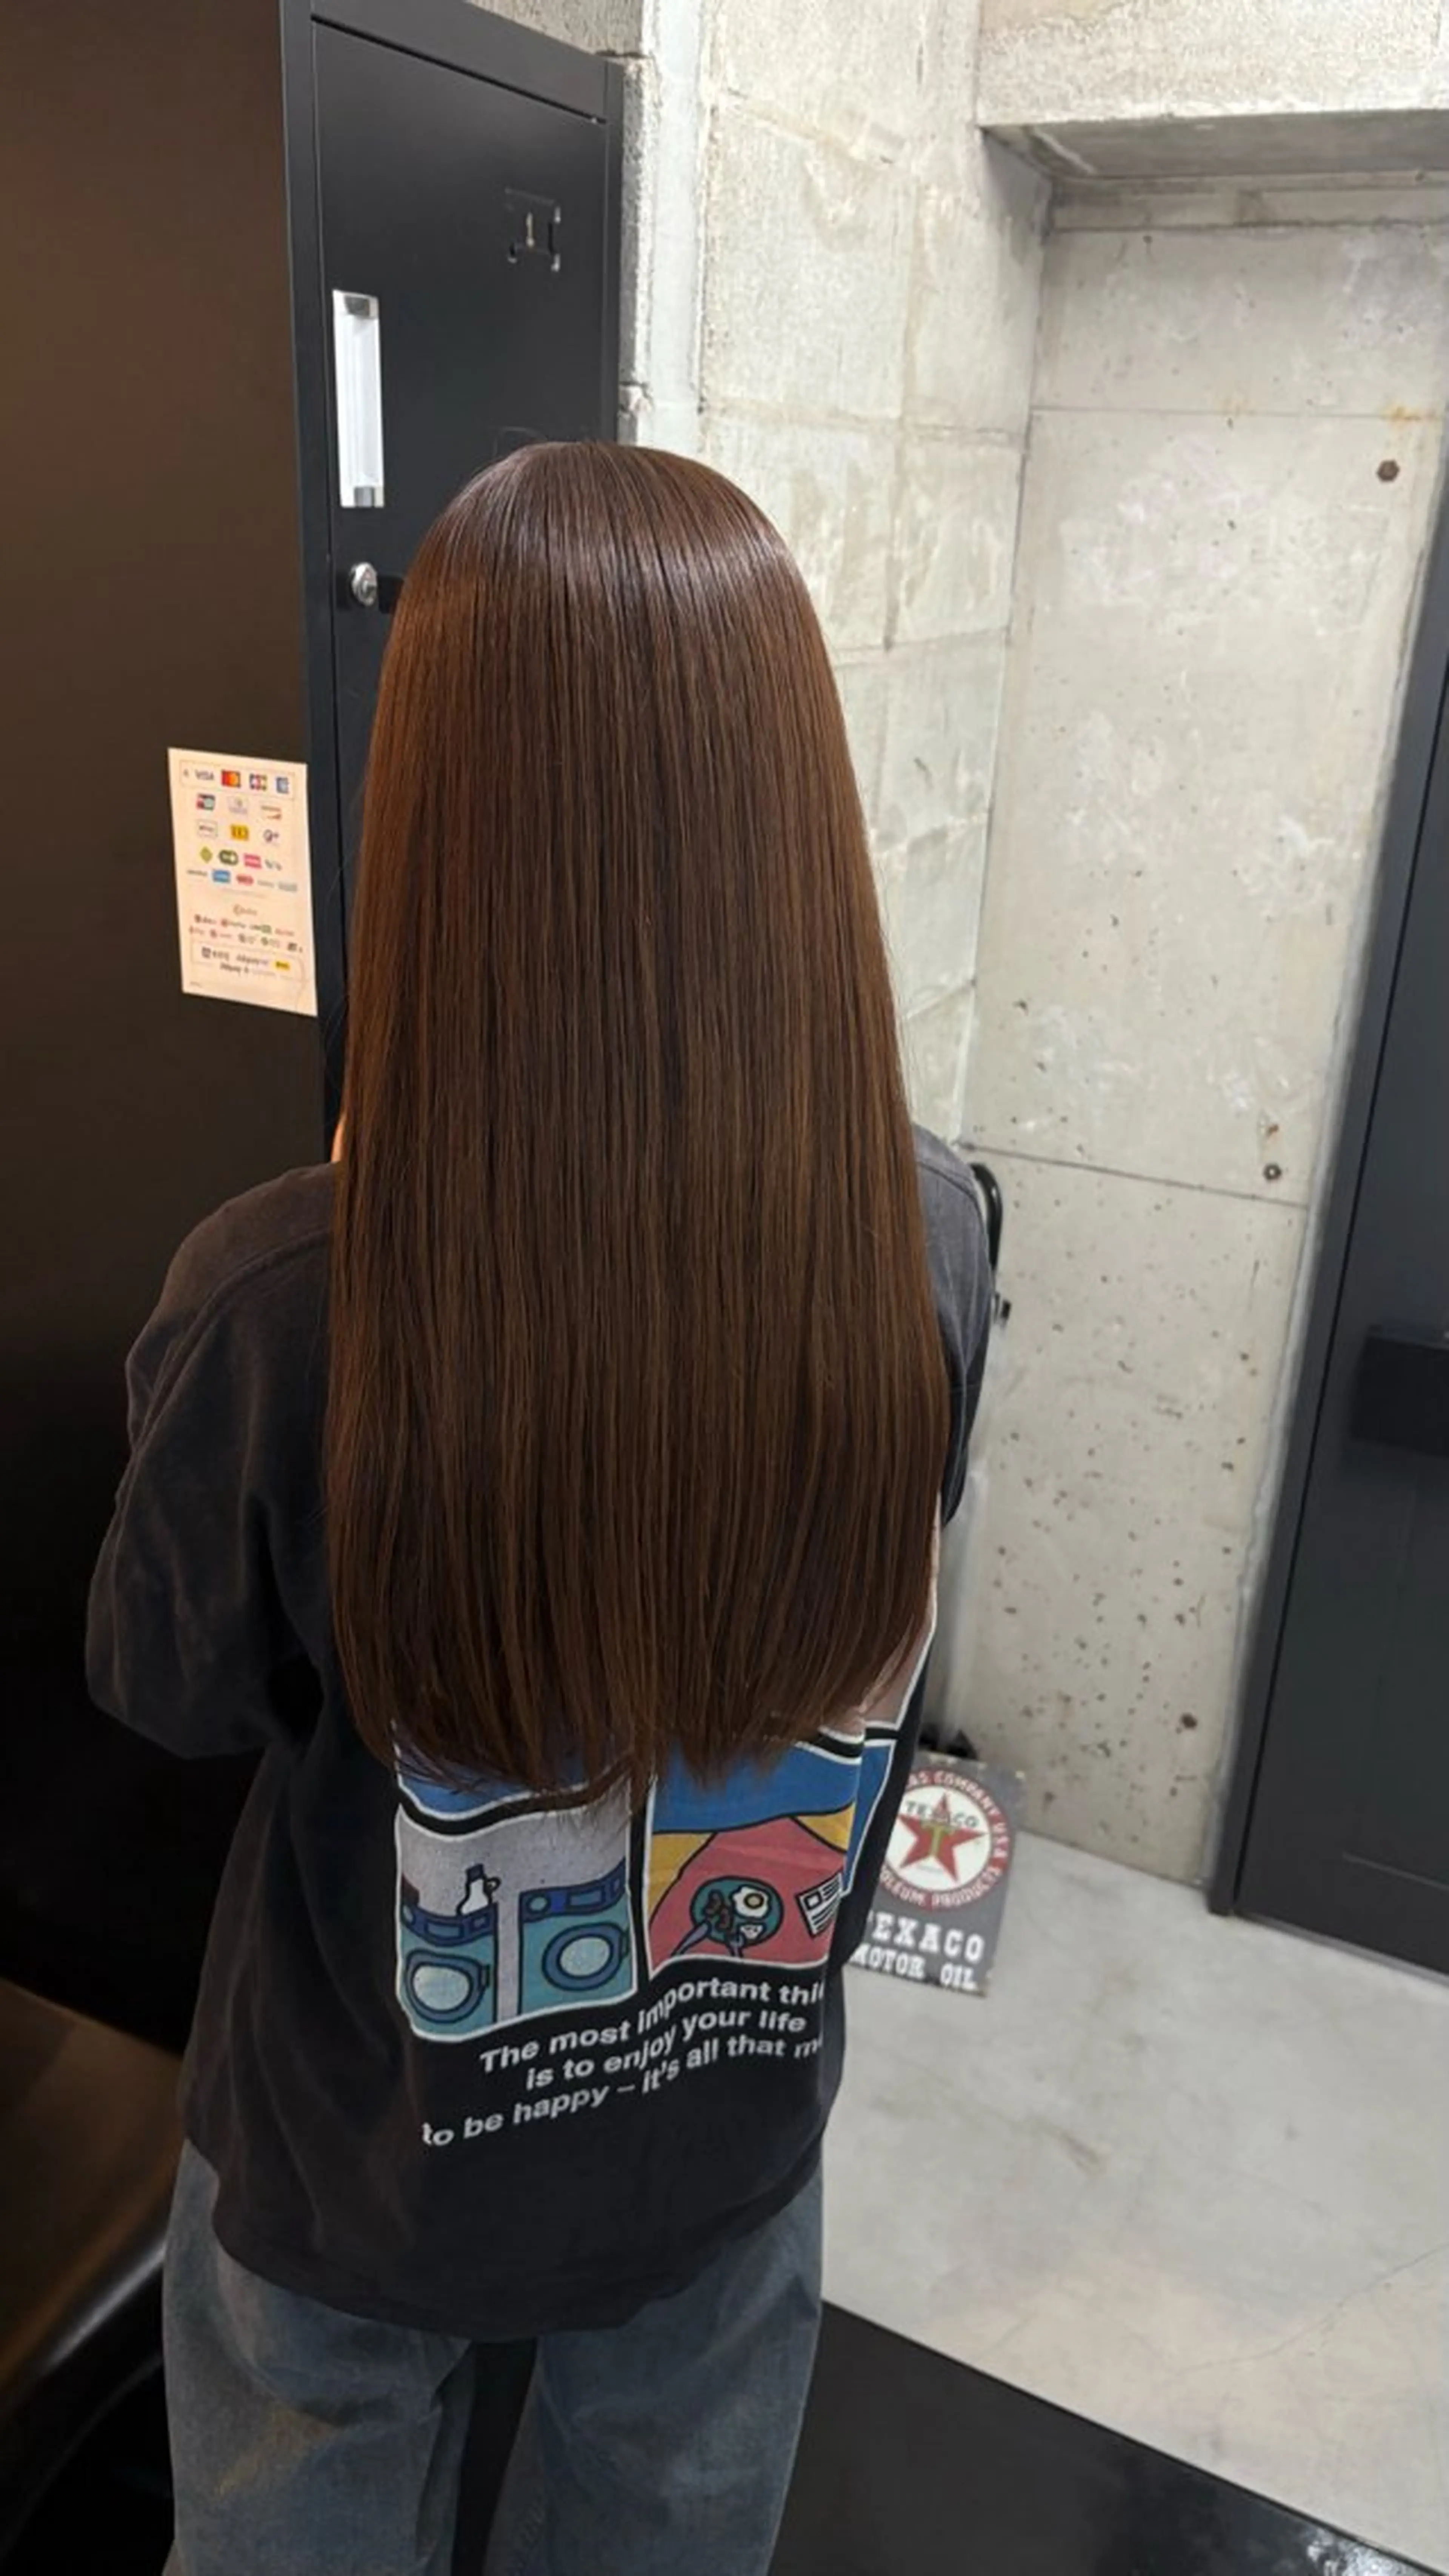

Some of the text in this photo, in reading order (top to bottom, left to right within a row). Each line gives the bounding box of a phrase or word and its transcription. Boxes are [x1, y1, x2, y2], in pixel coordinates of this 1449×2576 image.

[905, 1800, 981, 1829] TEXACO
[934, 1771, 1000, 1816] COMPANY
[868, 1910, 984, 1964] EXACO
[940, 1962, 978, 1991] OIL
[479, 2040, 540, 2073] The
[549, 2020, 631, 2054] most
[637, 1976, 772, 2034] important
[526, 2009, 808, 2091] is to enjoy your life
[421, 2121, 455, 2146] to
[463, 2113, 504, 2139] be
[513, 2085, 610, 2125] happy
[642, 2058, 680, 2094] it's
[686, 2038, 720, 2070] all
[727, 2034, 787, 2057] that
